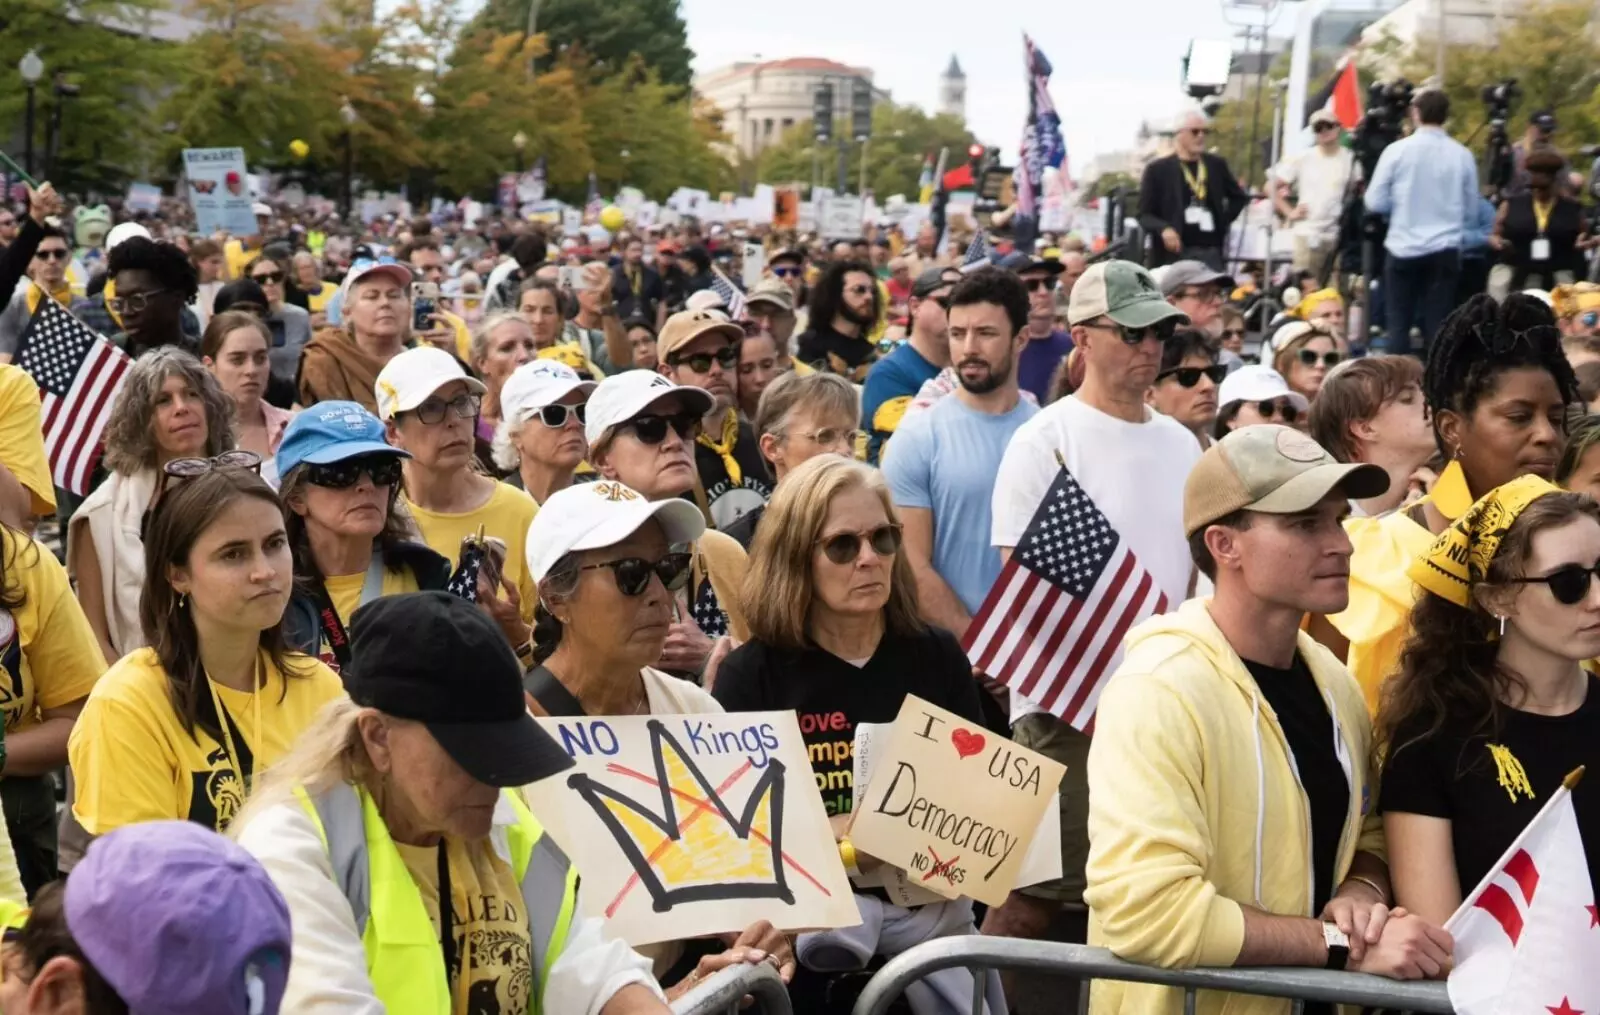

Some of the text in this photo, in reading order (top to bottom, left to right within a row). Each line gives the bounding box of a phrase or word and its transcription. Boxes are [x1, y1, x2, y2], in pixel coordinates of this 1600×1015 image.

[321, 608, 346, 647] Kodak
[557, 719, 779, 769] NO Kings
[798, 711, 852, 734] ove.
[914, 711, 1042, 797] I USA
[872, 761, 1018, 882] Democracy
[910, 852, 930, 872] NO
[931, 857, 968, 884] KINGS
